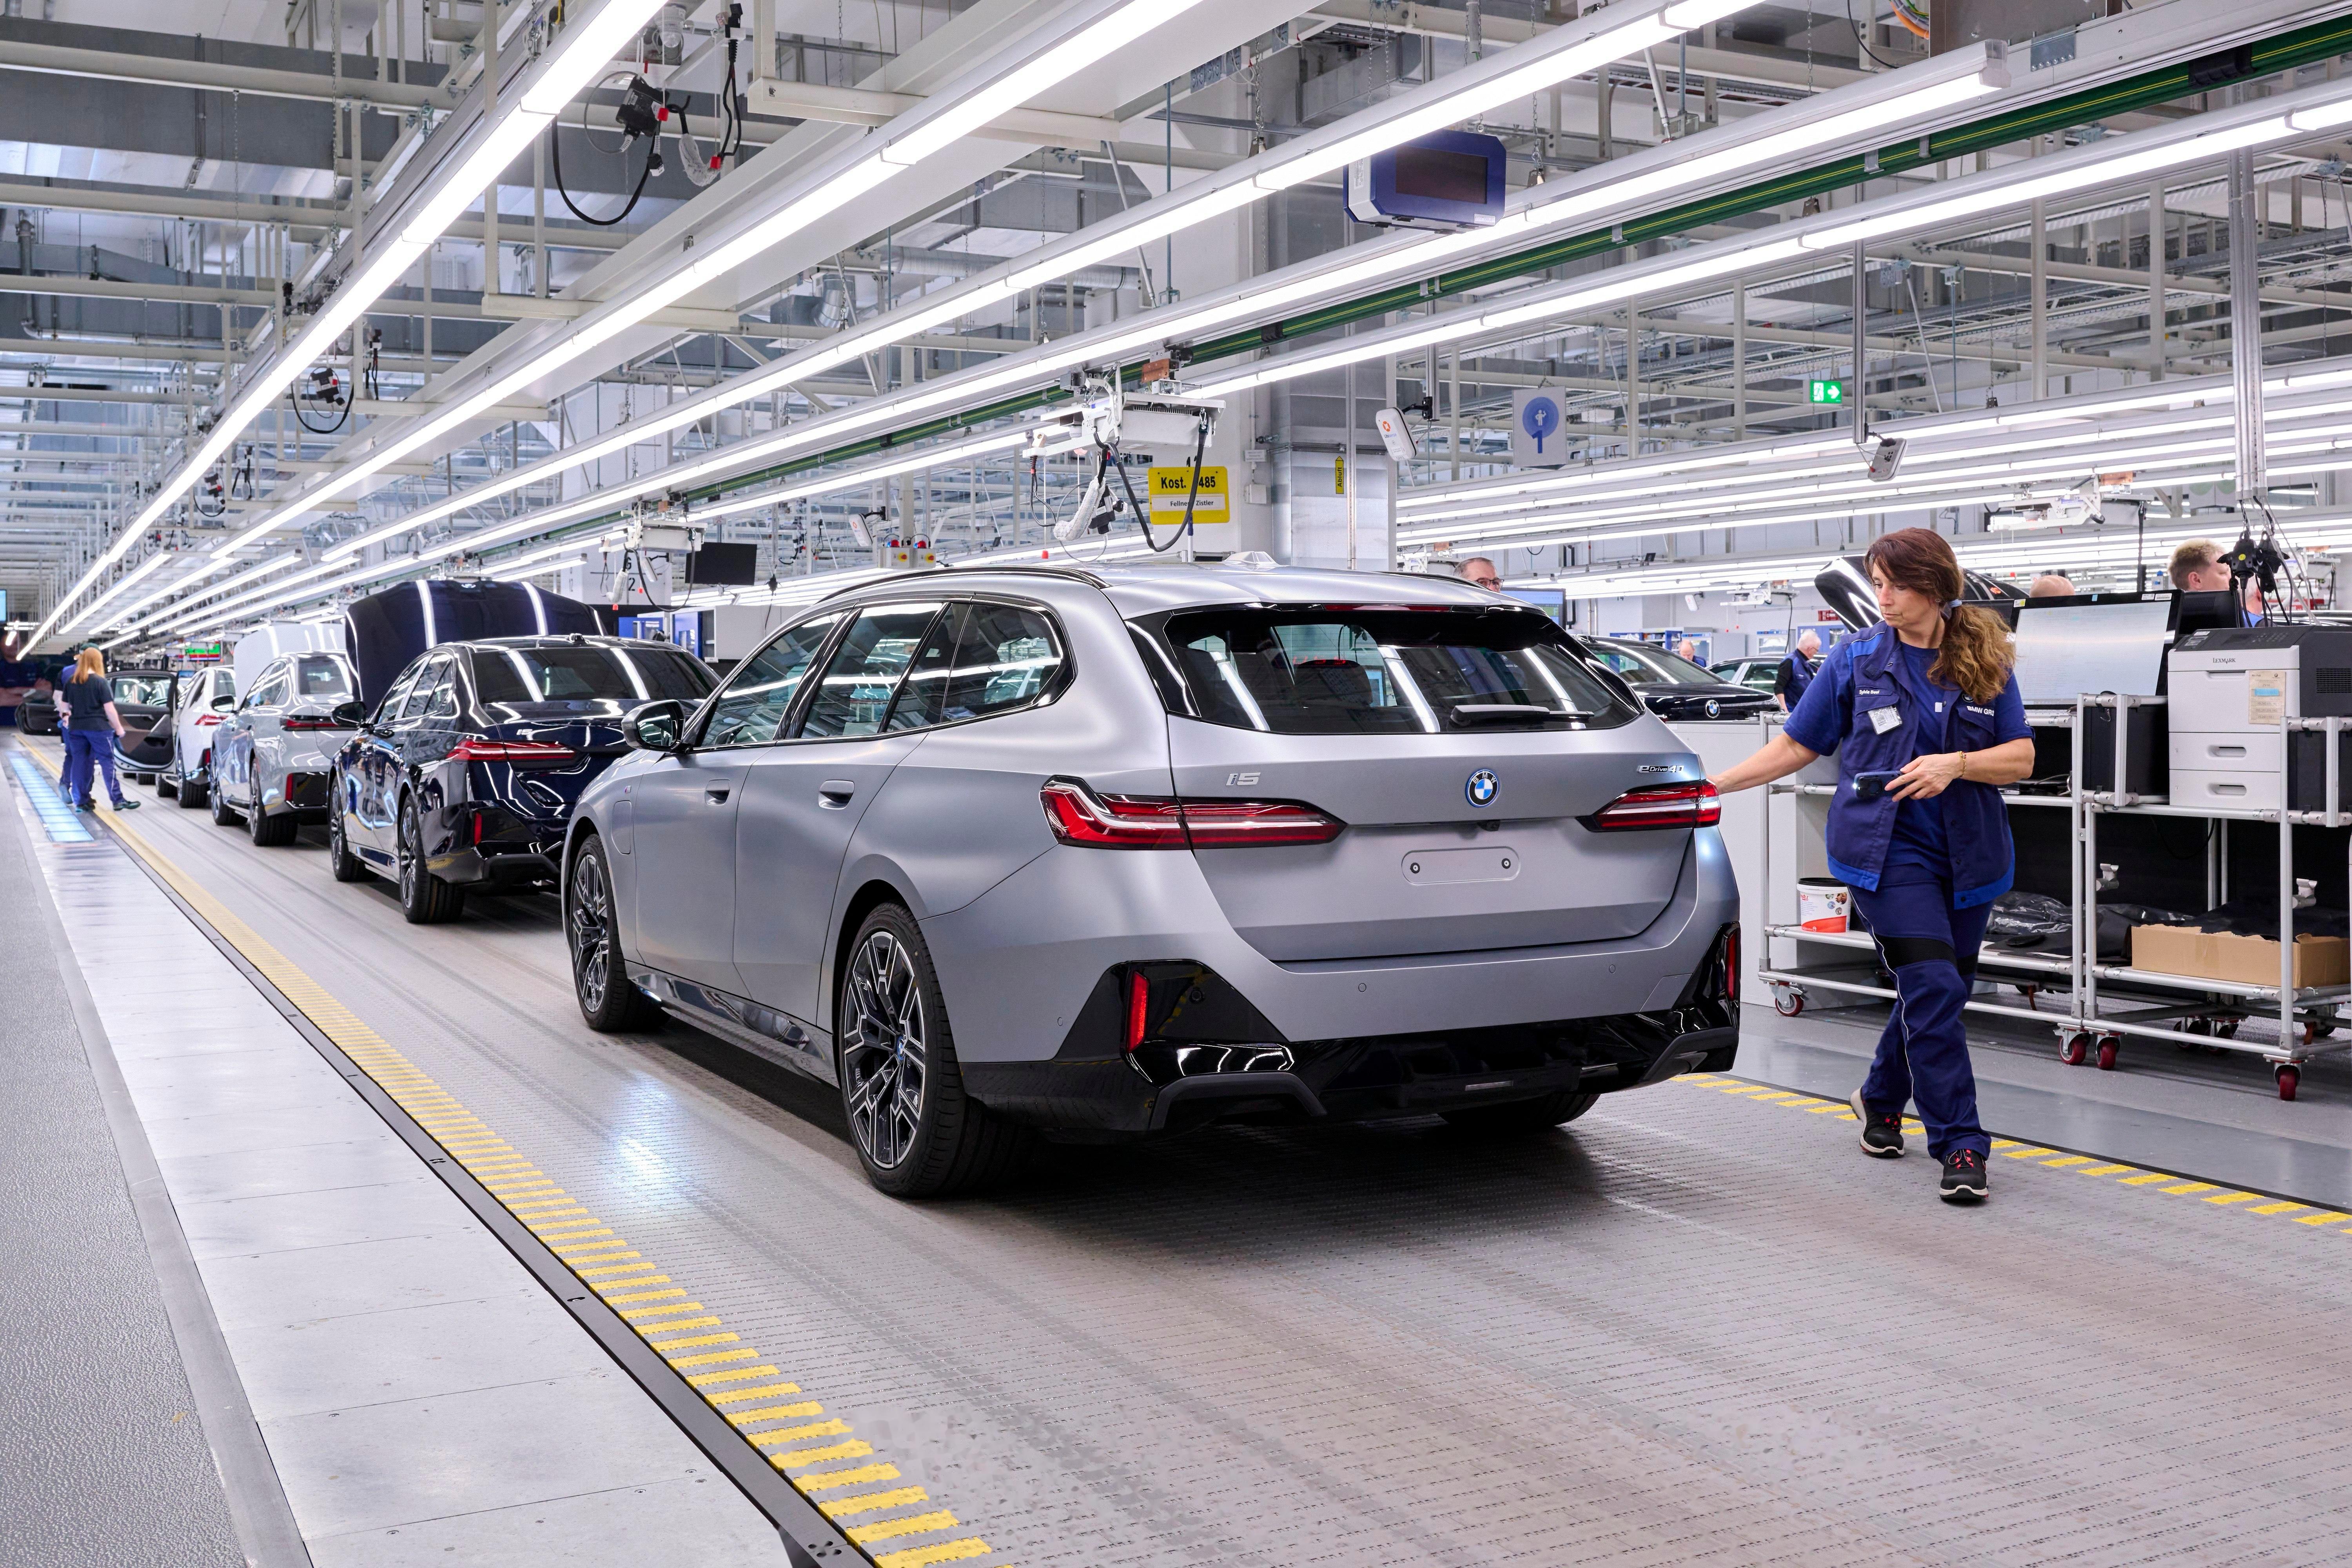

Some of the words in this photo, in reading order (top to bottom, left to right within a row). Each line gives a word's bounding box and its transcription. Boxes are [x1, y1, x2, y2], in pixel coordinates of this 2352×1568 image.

[1532, 430, 1543, 454] 1
[1161, 477, 1186, 489] Kost.
[1226, 772, 1261, 786] i5
[1472, 772, 1497, 784] BMW
